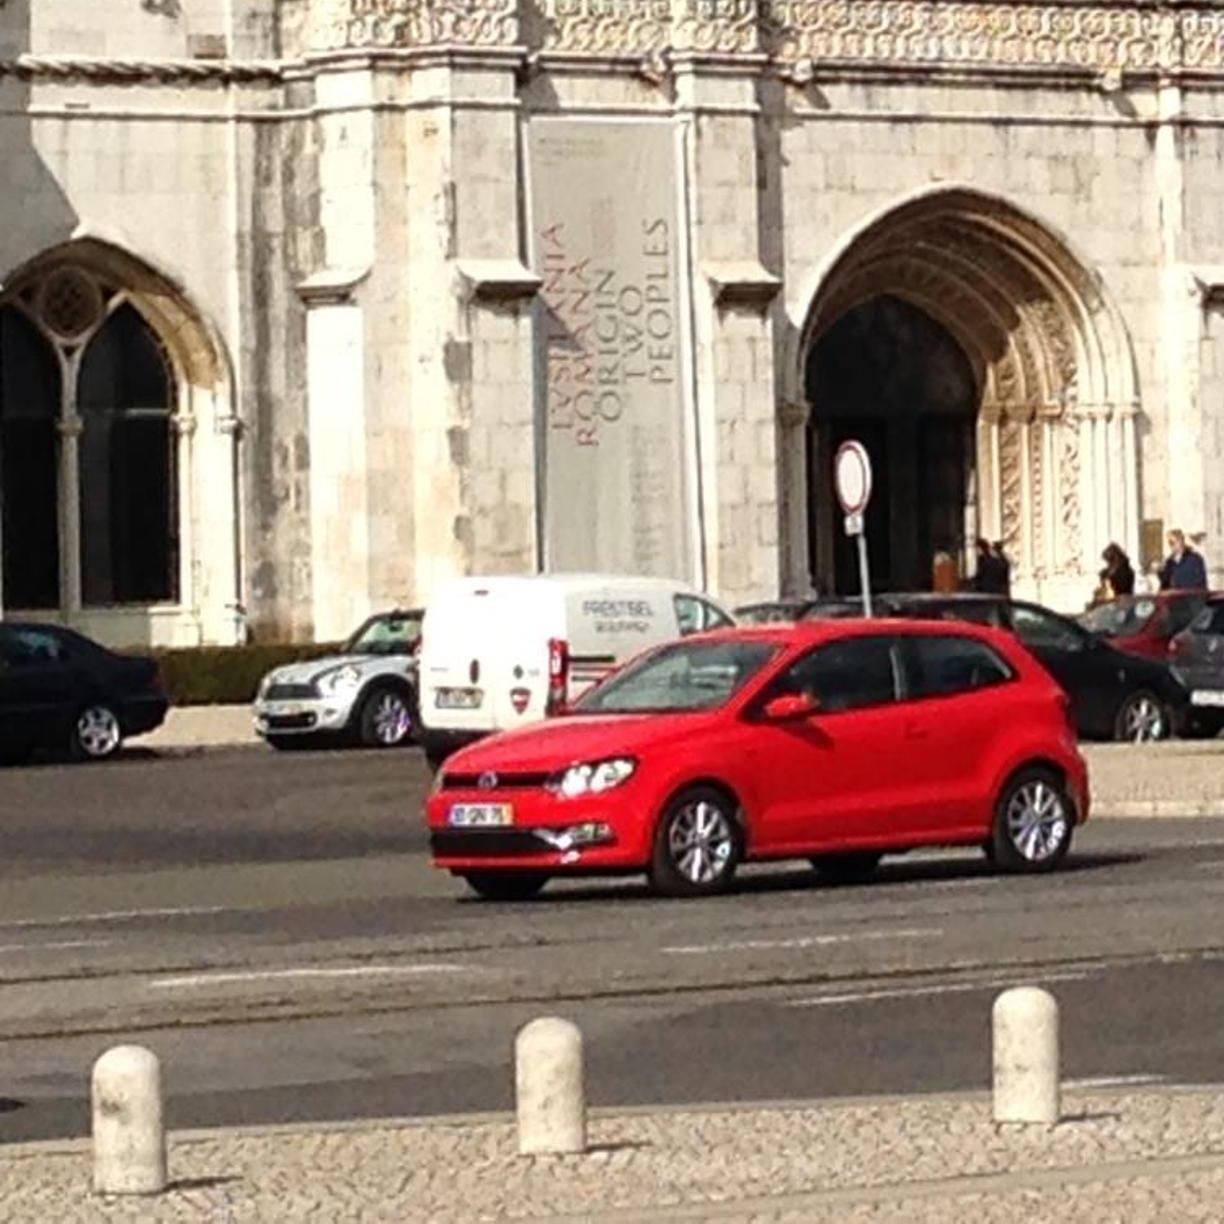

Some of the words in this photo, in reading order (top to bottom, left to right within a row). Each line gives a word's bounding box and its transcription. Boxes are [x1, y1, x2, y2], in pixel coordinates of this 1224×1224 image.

[568, 257, 599, 447] ROMANA
[596, 268, 622, 422] ORIGIN
[619, 285, 647, 378] TWO
[643, 218, 674, 384] PEOPLES
